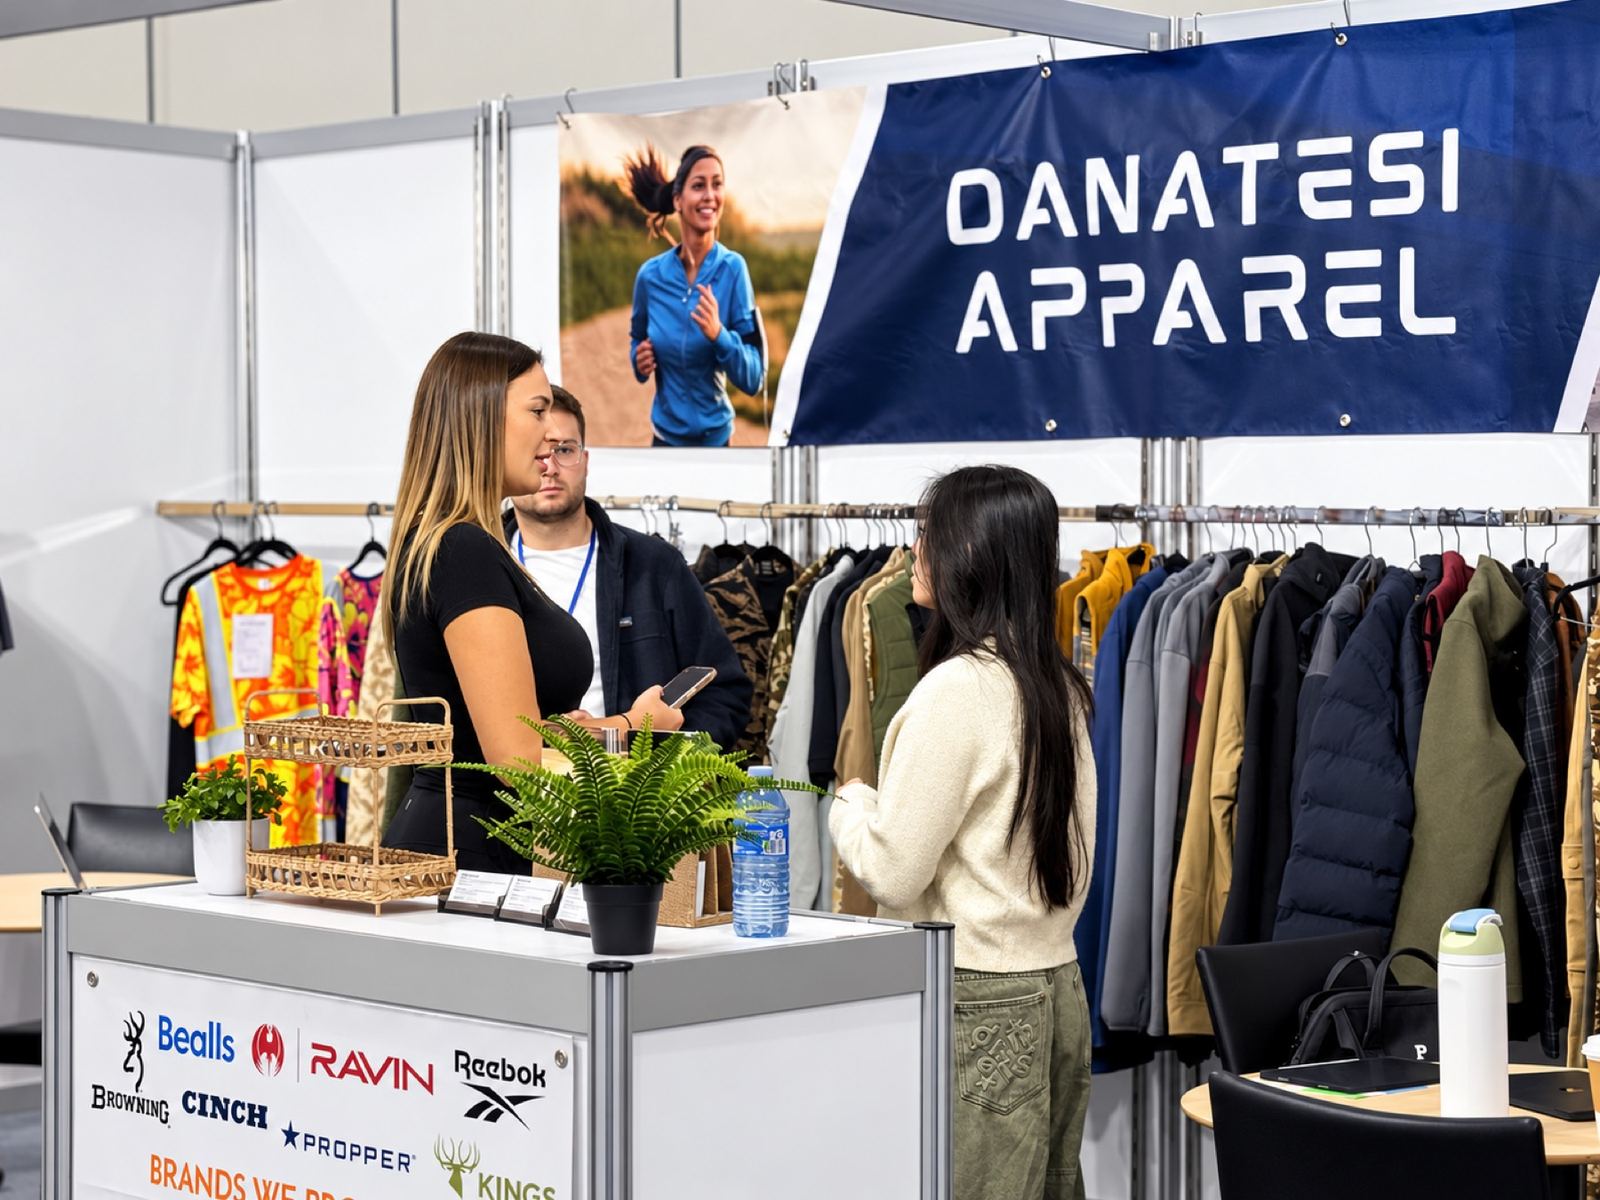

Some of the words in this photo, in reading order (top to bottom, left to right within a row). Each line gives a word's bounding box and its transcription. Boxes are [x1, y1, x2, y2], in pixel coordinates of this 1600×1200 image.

[955, 246, 1456, 353] APPAREL
[158, 1014, 236, 1063] Bealls
[311, 1042, 434, 1096] RAVIN
[454, 1049, 546, 1088] Reebok
[91, 1083, 170, 1125] BROWNING
[181, 1090, 268, 1130] CINCH
[303, 1132, 411, 1173] PROPPER
[150, 1153, 247, 1200] BRANDS
[478, 1172, 556, 1200] KINGS
